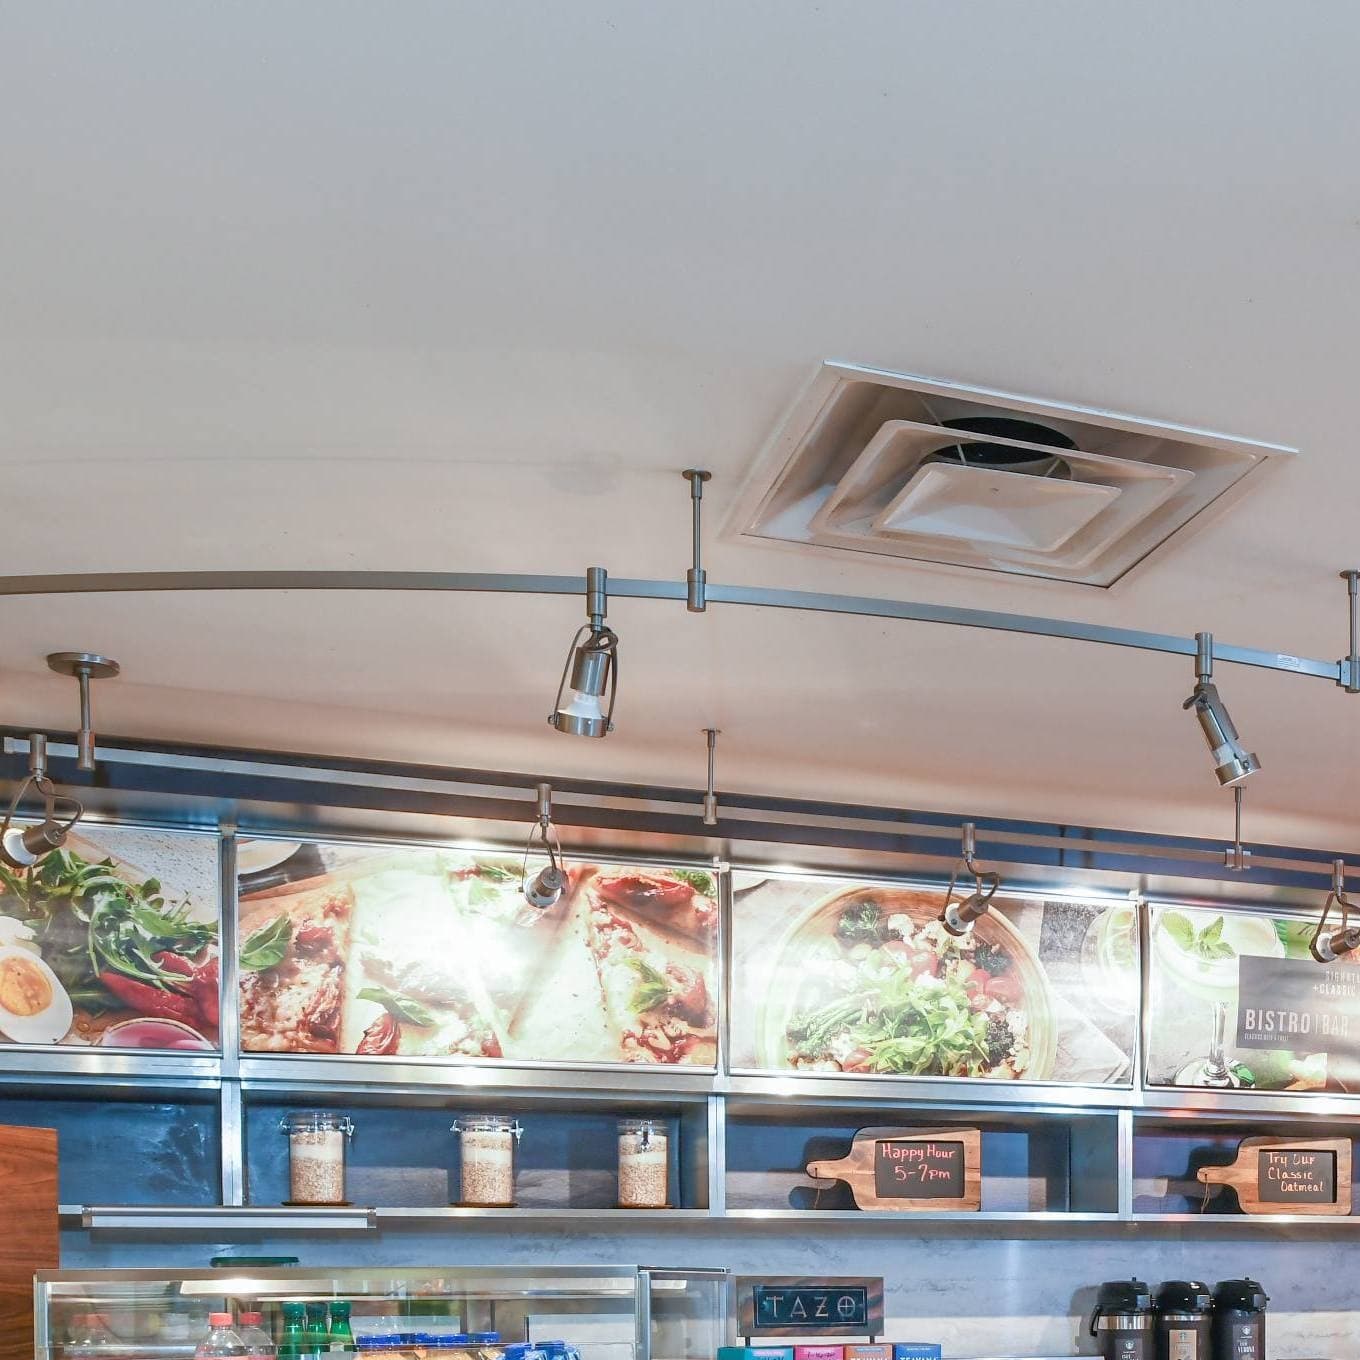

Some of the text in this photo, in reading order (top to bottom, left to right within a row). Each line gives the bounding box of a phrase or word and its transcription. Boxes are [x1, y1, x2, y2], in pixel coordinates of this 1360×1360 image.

[1245, 1009, 1349, 1036] BISTRO BAR
[882, 1143, 956, 1162] Happy Hour
[1265, 1152, 1316, 1168] Try Our
[1268, 1167, 1313, 1180] Classic
[1280, 1181, 1324, 1192] Oatmeal
[766, 1296, 856, 1318] TAZO
